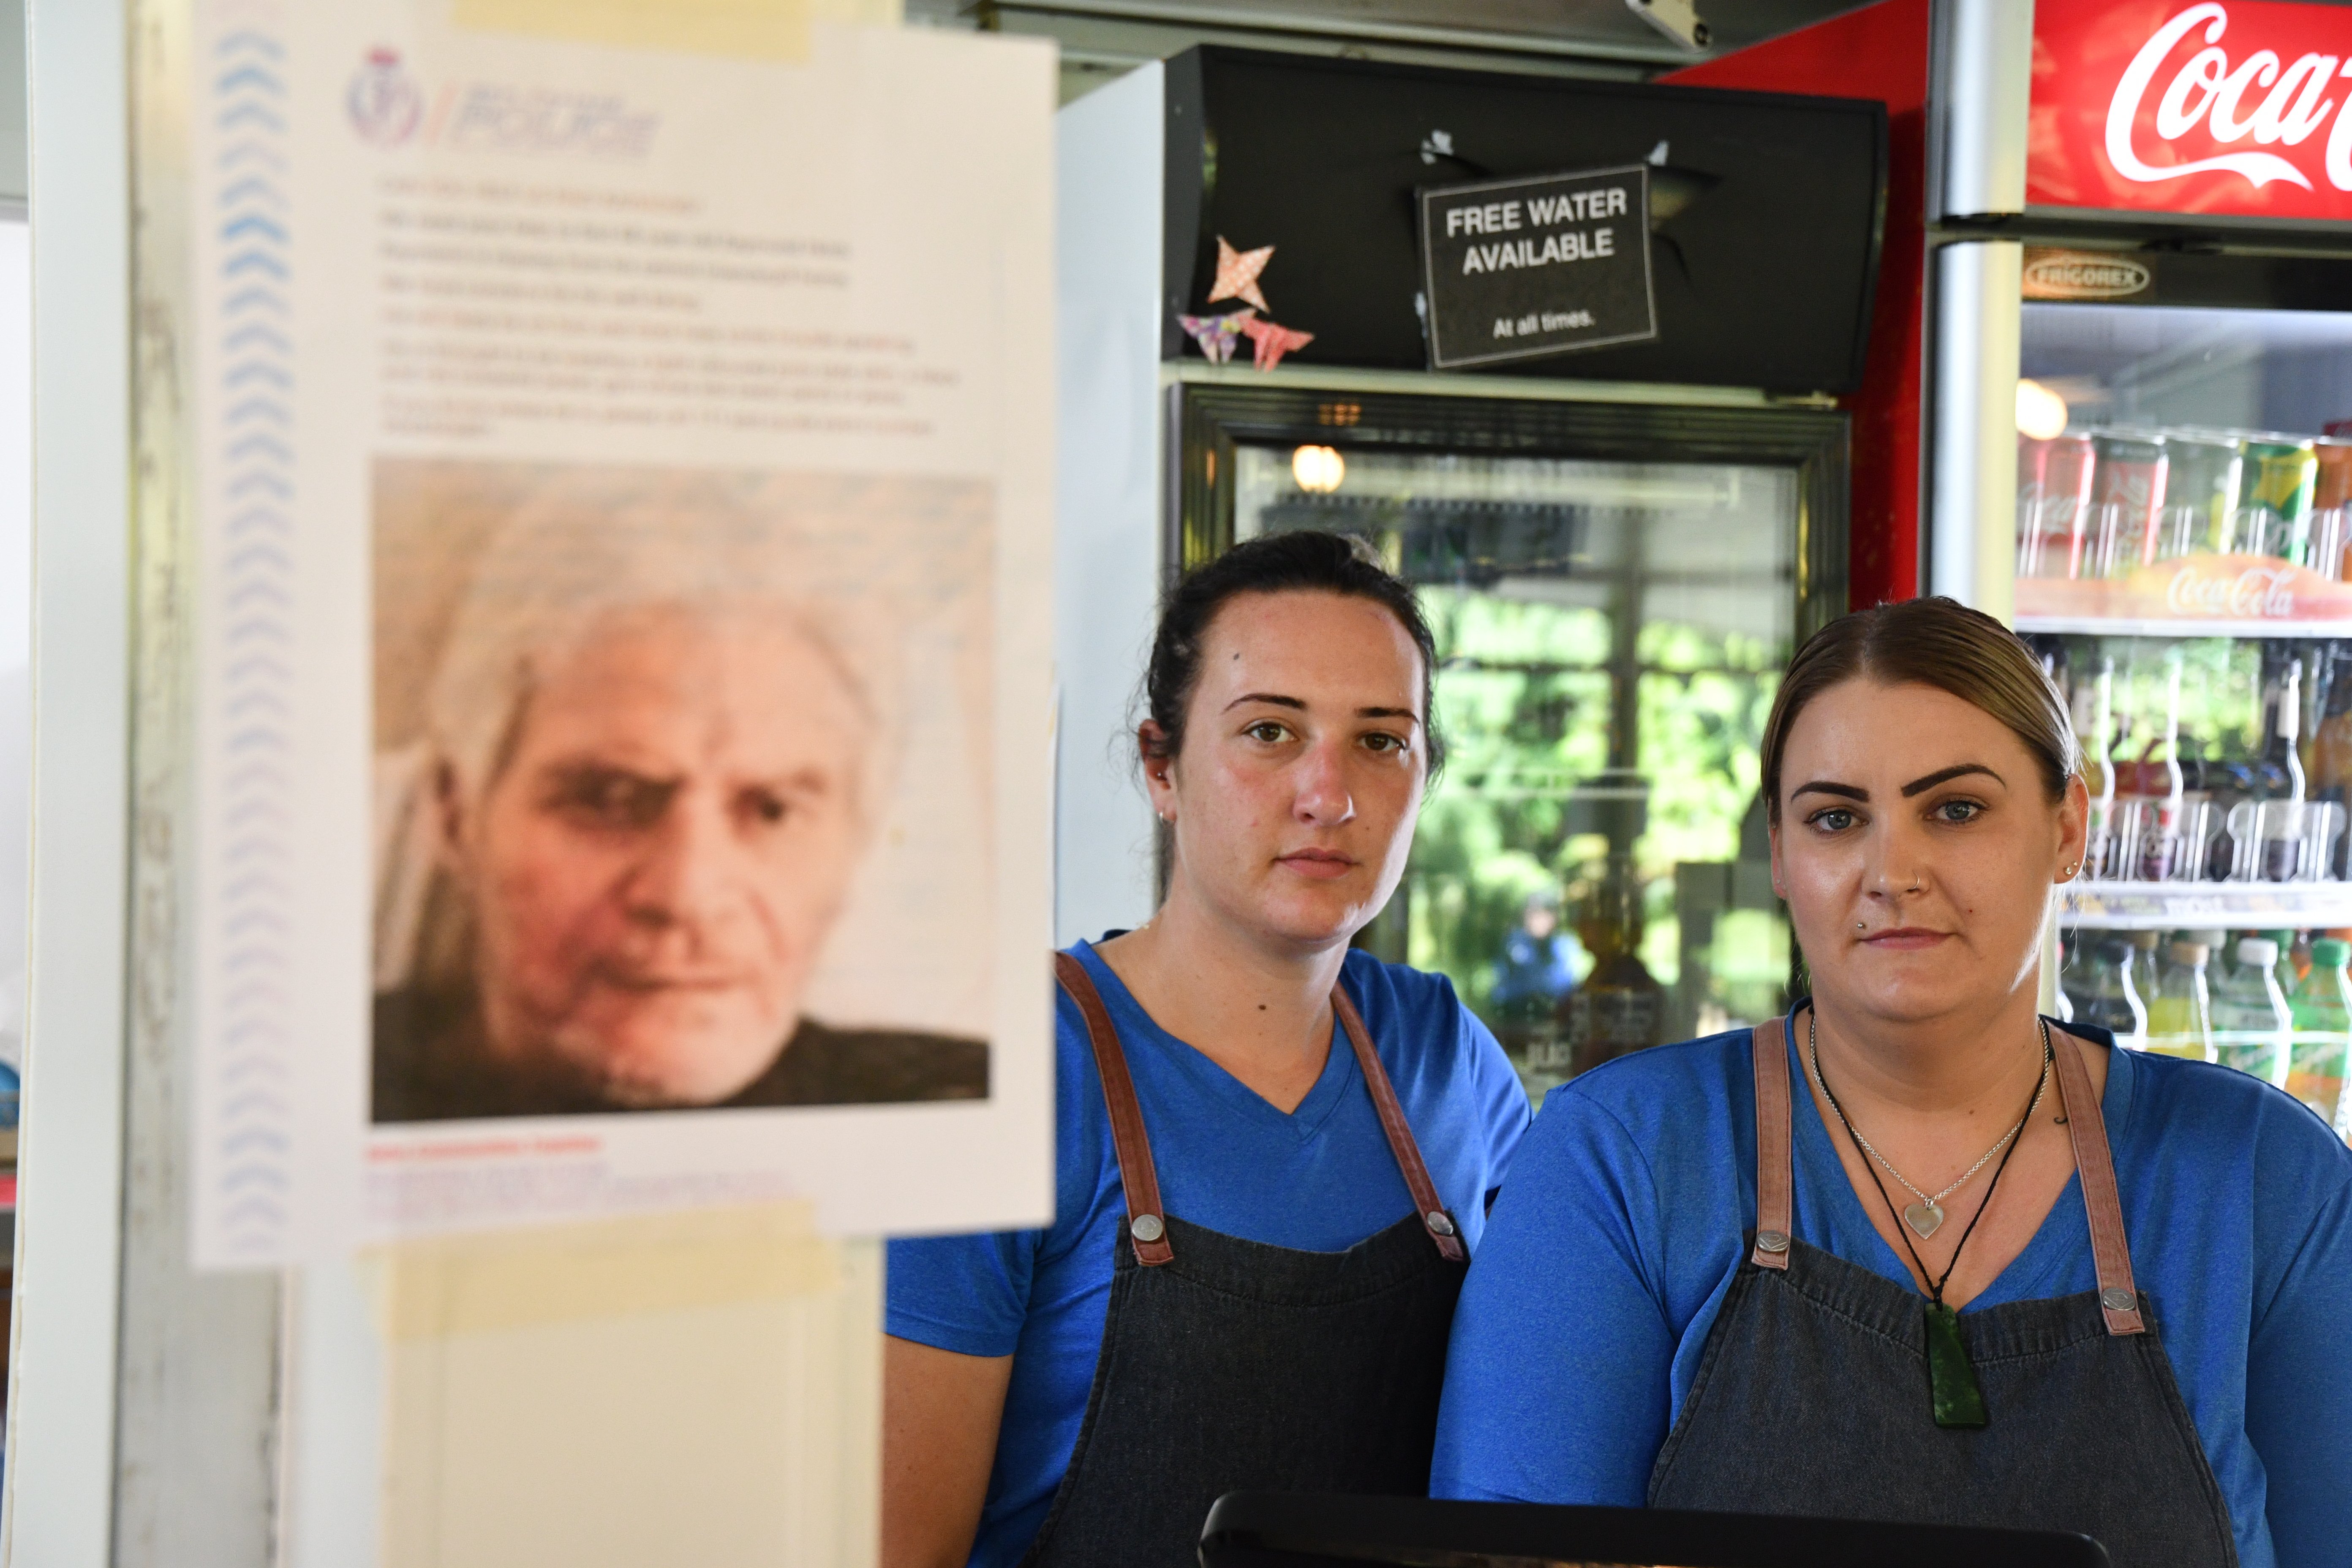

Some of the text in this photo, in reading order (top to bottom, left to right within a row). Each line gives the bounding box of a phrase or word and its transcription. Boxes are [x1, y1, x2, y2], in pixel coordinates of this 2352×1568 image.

[1446, 187, 1627, 238] FREE WATER
[1462, 227, 1615, 275] AVAILABLE
[1493, 309, 1595, 338] At all times.
